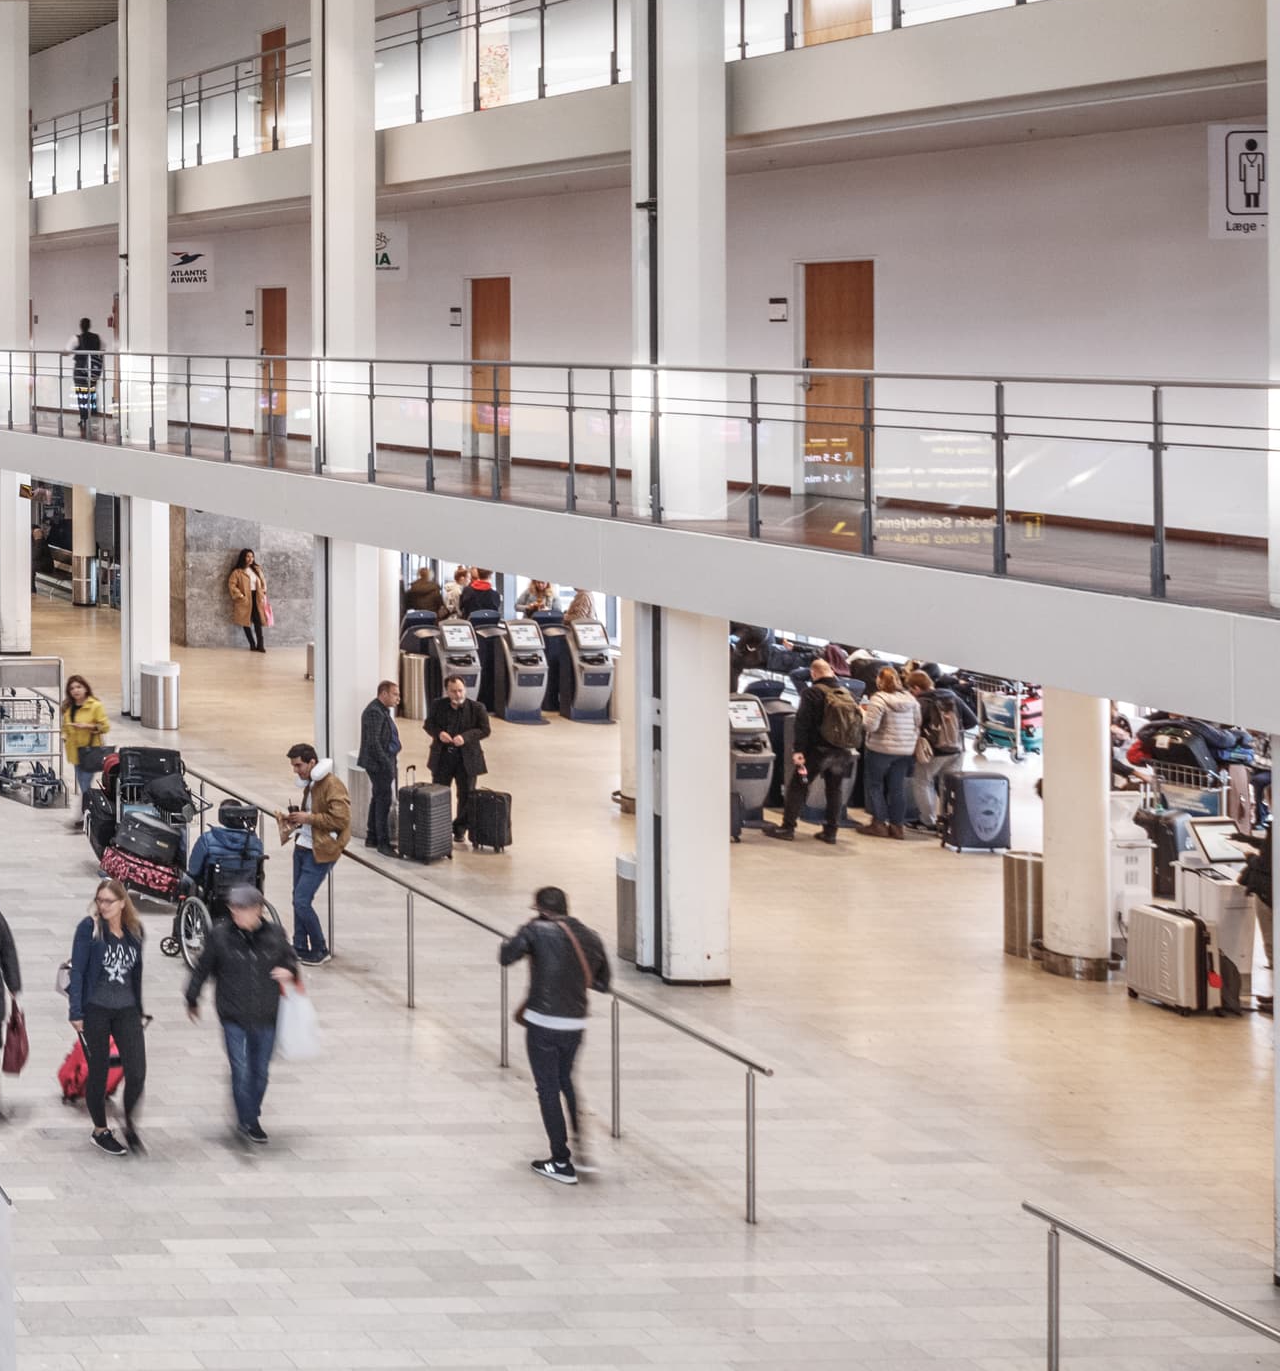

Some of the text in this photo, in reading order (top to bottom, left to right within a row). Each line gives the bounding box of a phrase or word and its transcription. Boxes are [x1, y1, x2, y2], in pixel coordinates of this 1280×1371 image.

[1225, 221, 1257, 233] Læge
[376, 252, 391, 265] IA
[170, 269, 207, 277] ATLANTIC
